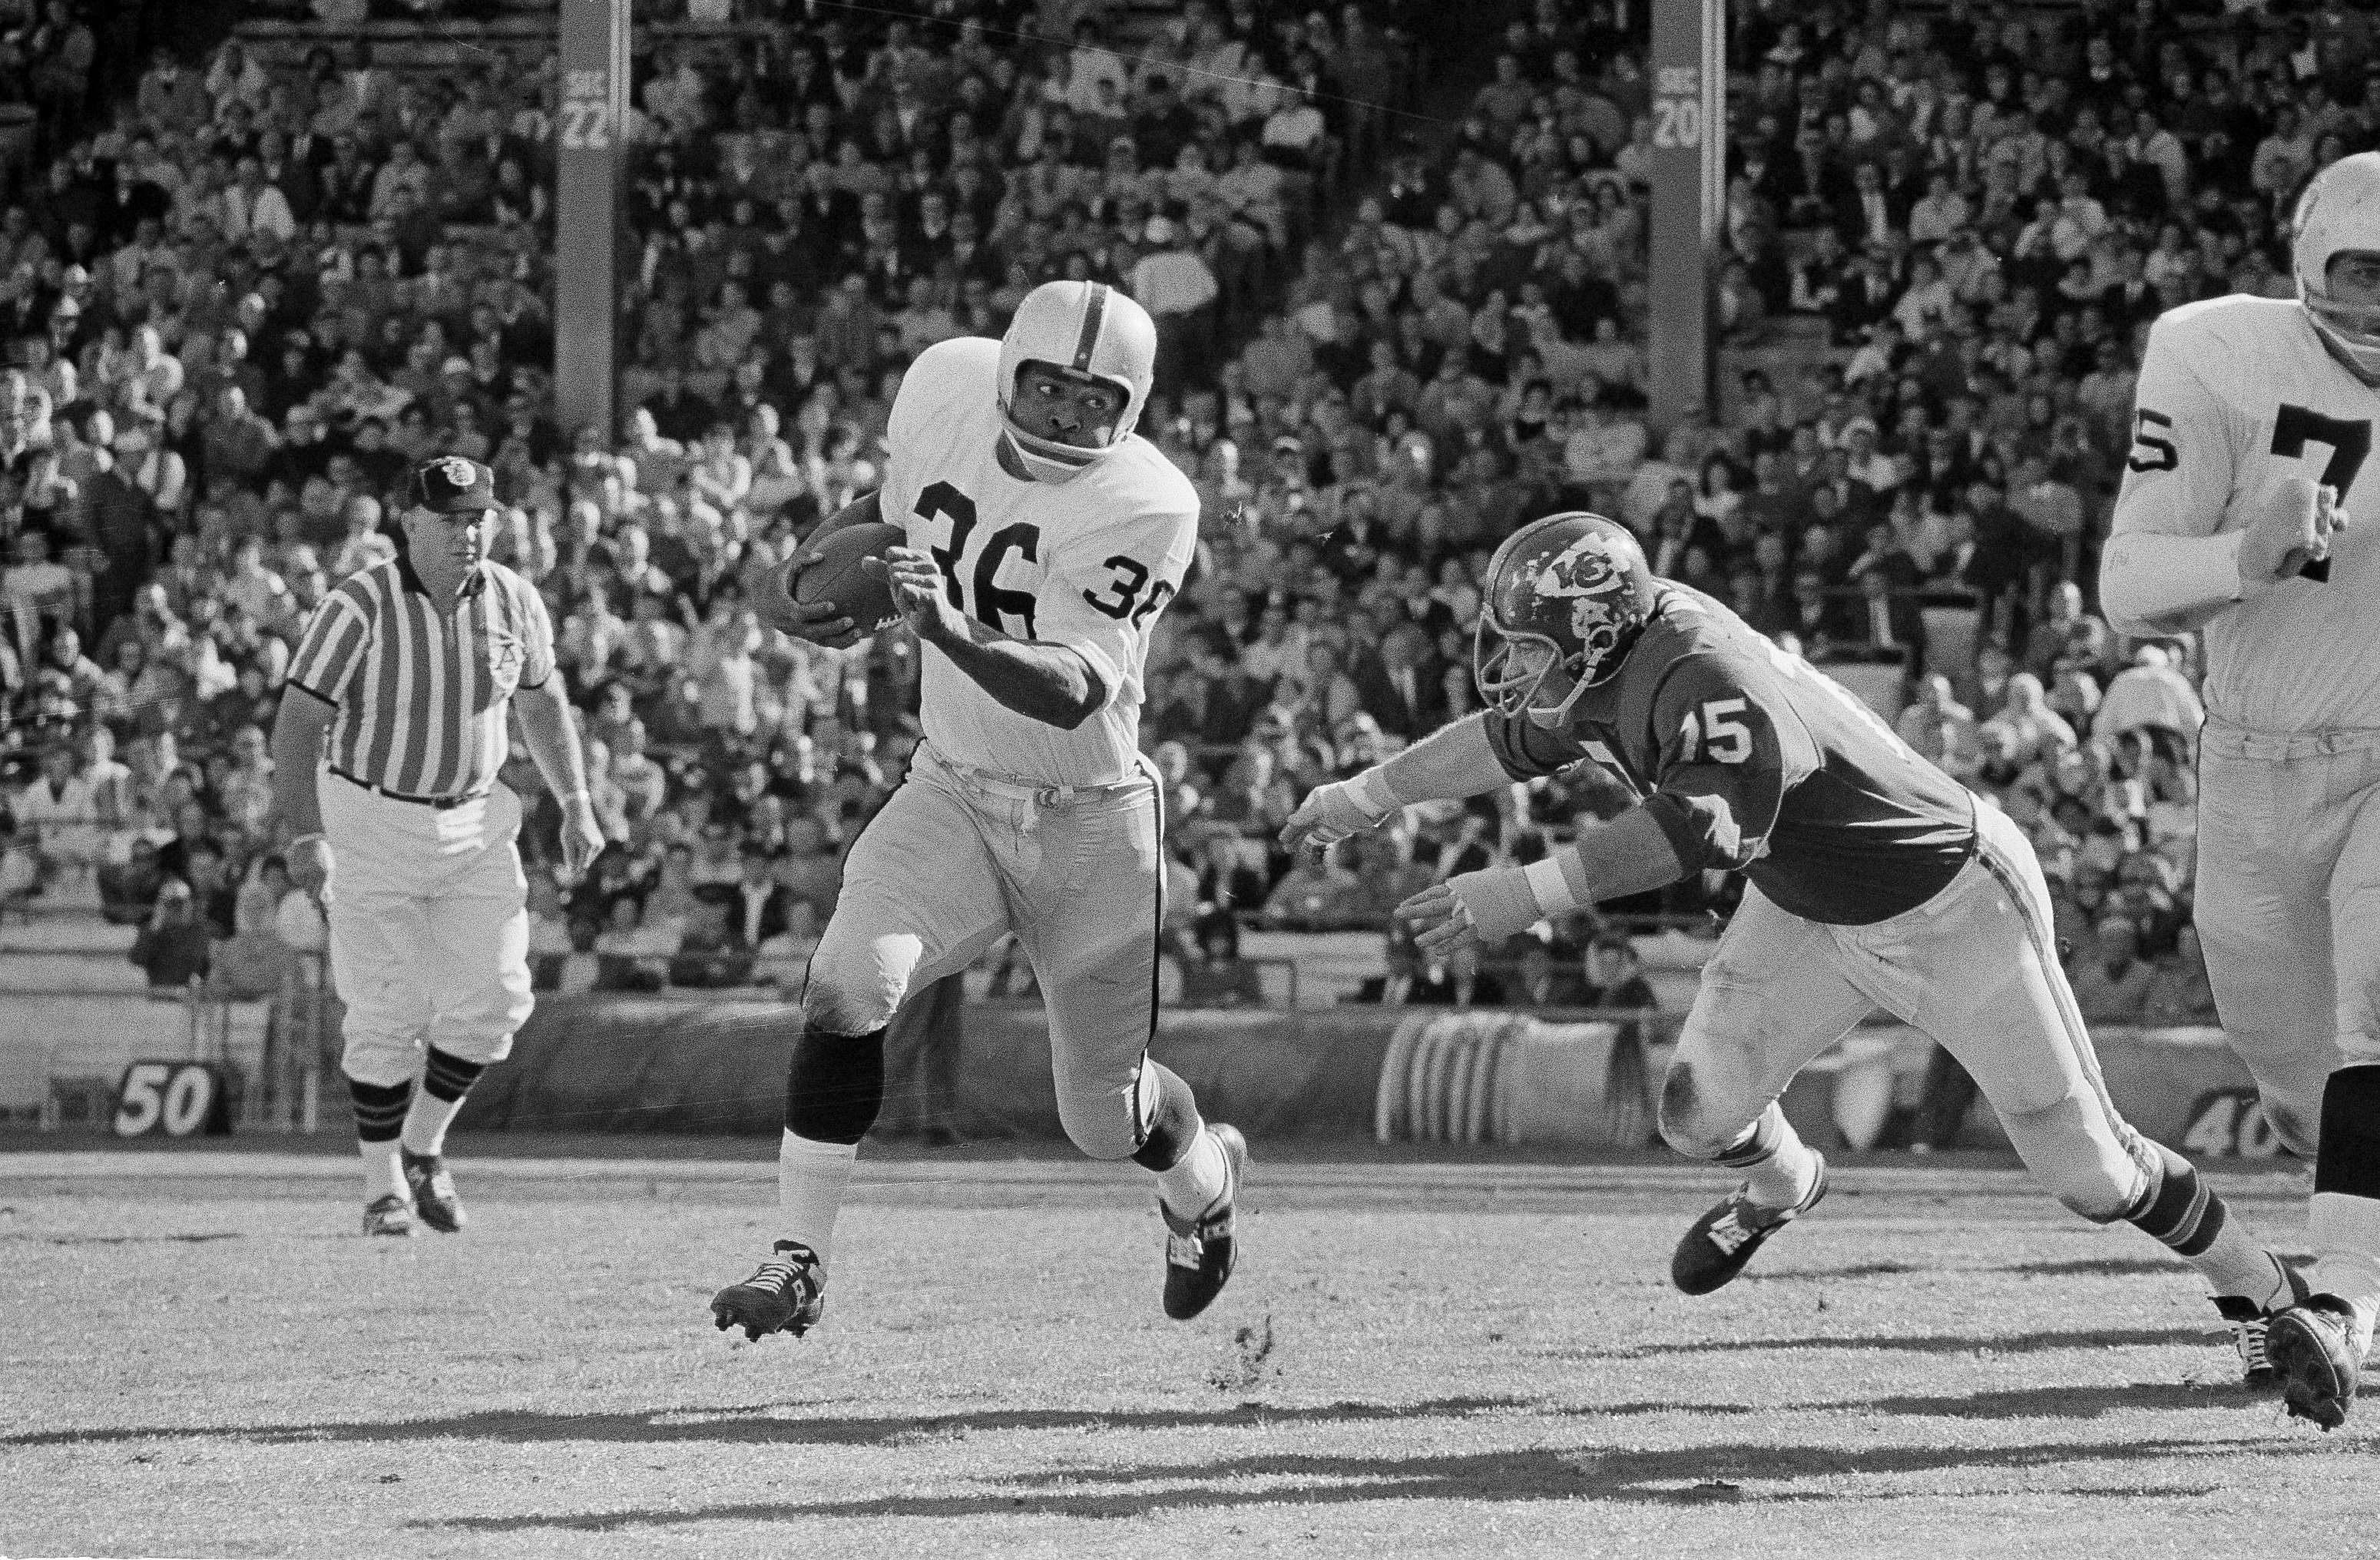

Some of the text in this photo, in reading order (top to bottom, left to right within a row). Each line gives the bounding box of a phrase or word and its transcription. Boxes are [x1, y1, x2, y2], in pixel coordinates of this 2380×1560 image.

[563, 101, 610, 147] 22
[1654, 101, 1701, 146] 20
[1679, 697, 1752, 763] 15
[115, 1065, 212, 1137] 50
